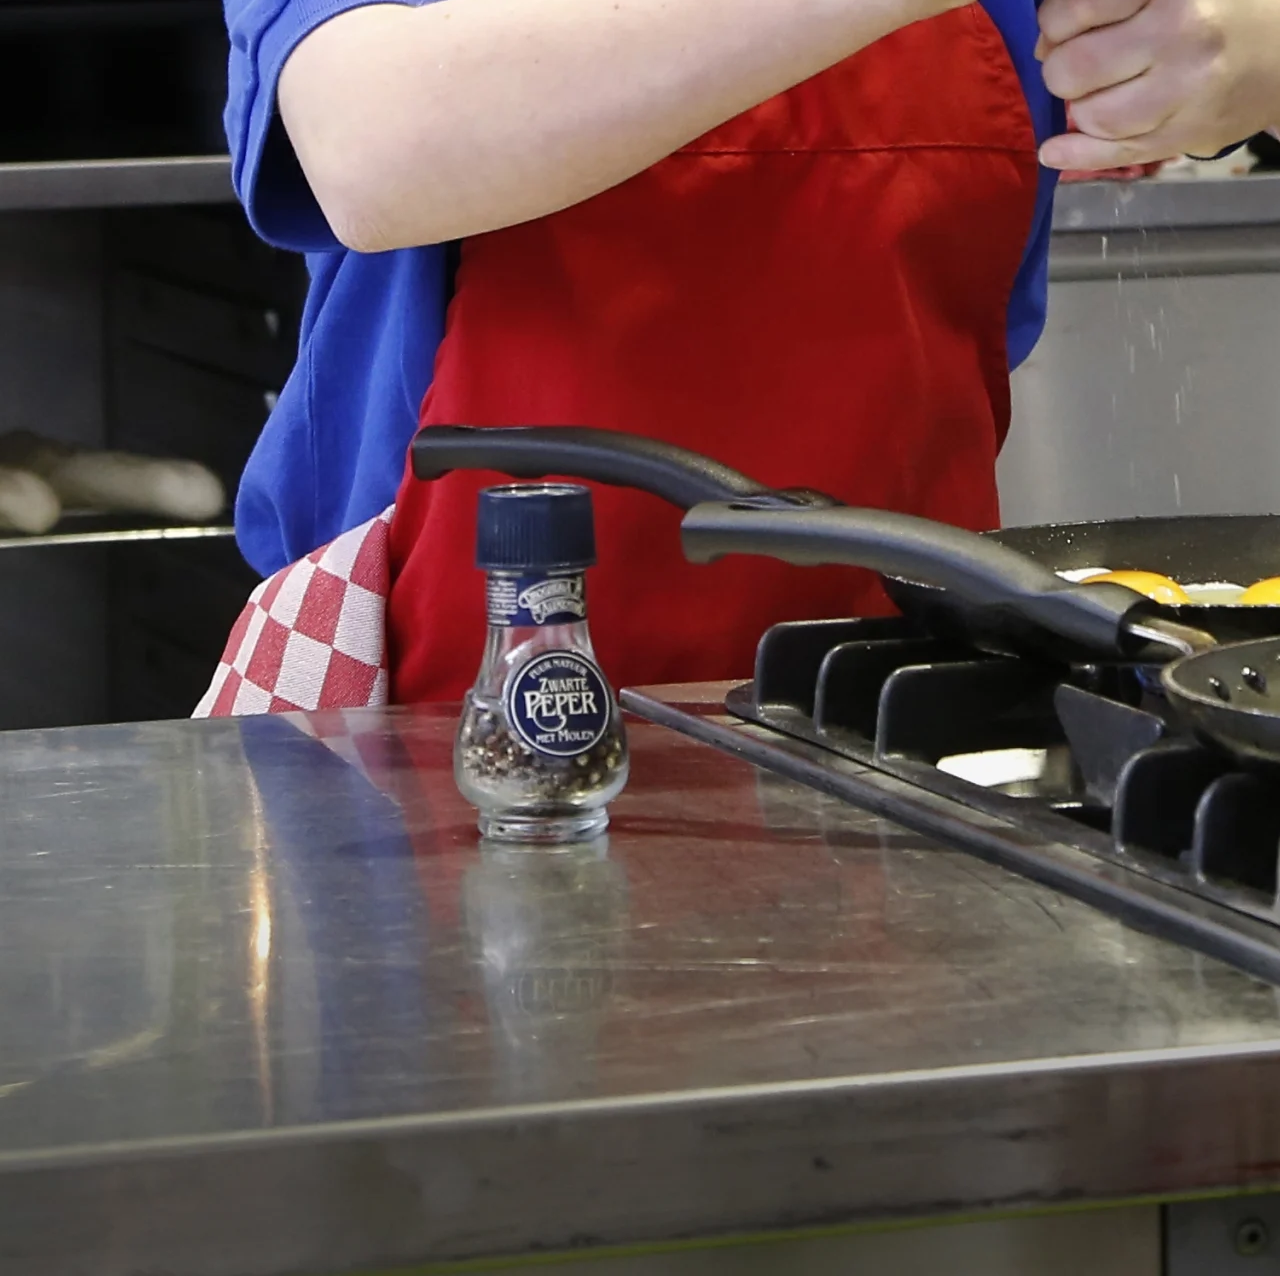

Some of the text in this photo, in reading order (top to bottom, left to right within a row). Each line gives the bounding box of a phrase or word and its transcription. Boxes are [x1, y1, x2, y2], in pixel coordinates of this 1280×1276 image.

[528, 659, 588, 679] PUUR NATUUR
[539, 677, 589, 693] ZWARTE
[523, 691, 598, 730] PEPER
[536, 729, 594, 744] MET MOLEN
